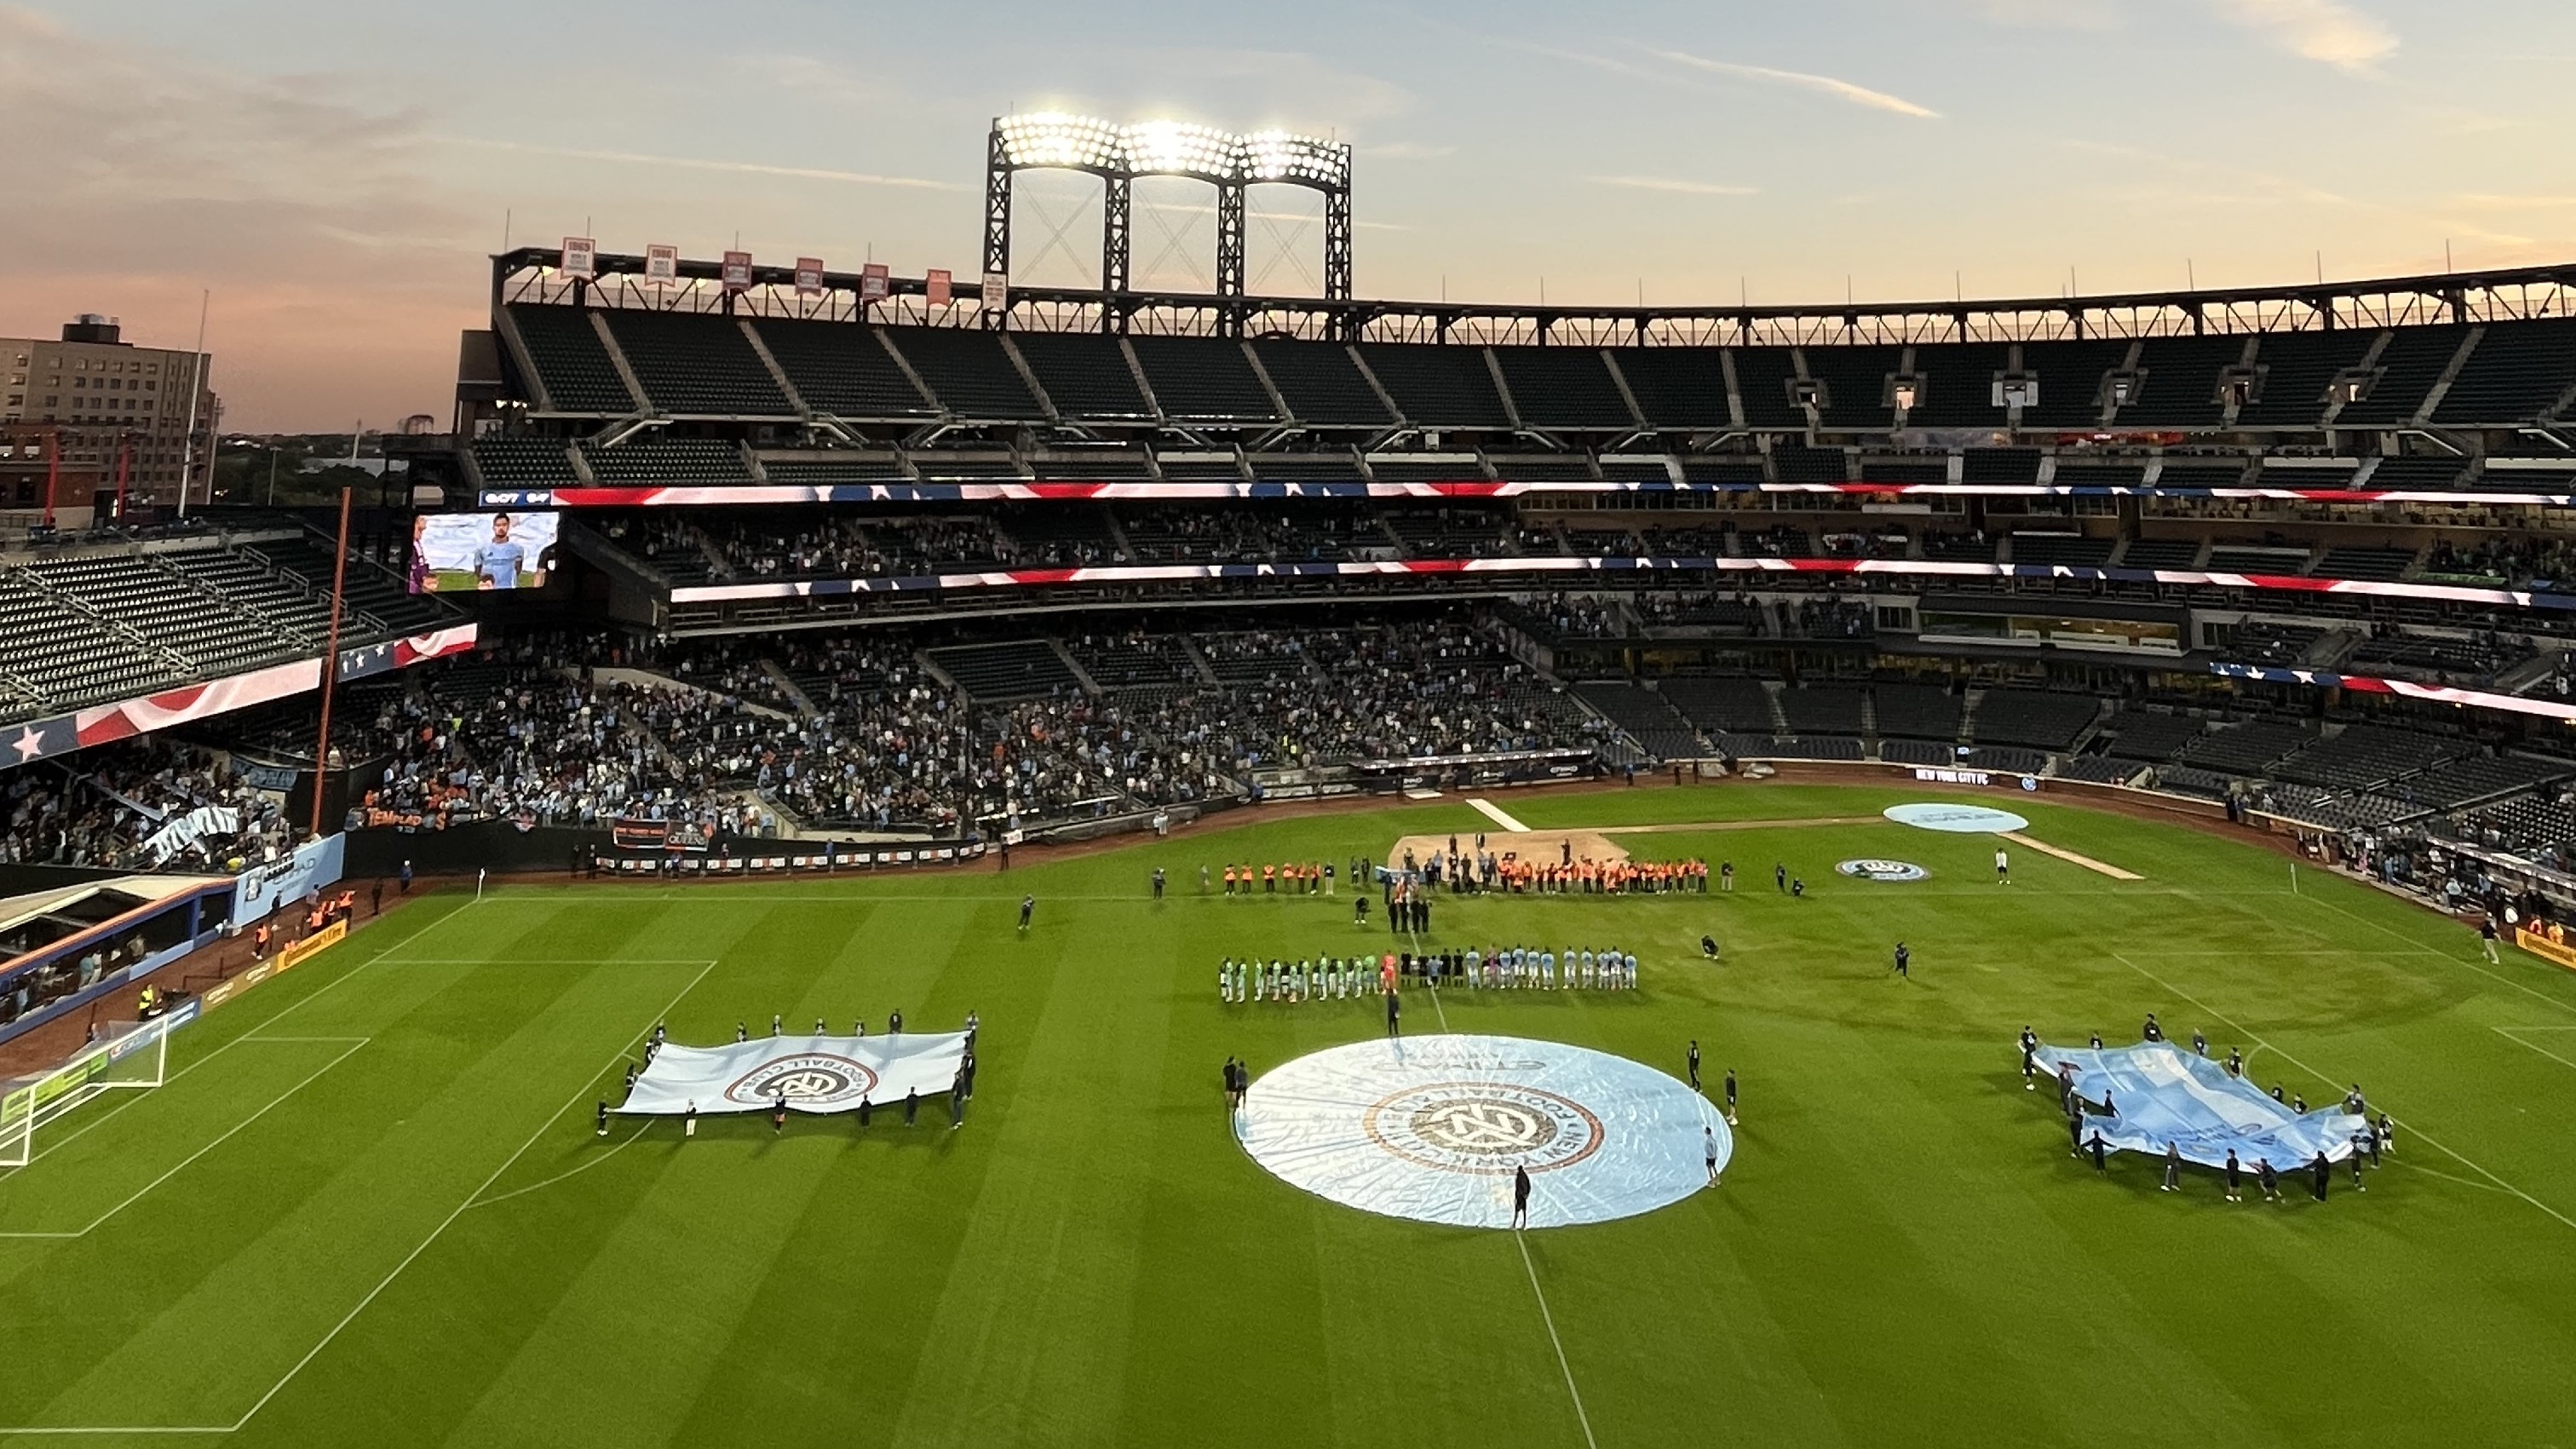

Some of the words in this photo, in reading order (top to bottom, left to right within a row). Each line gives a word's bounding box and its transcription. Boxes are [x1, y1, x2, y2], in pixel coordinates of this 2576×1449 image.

[1916, 768, 1935, 781] NEW
[1936, 770, 1958, 783] YORK
[1958, 772, 1977, 785] CITY
[1977, 773, 1989, 785] FC
